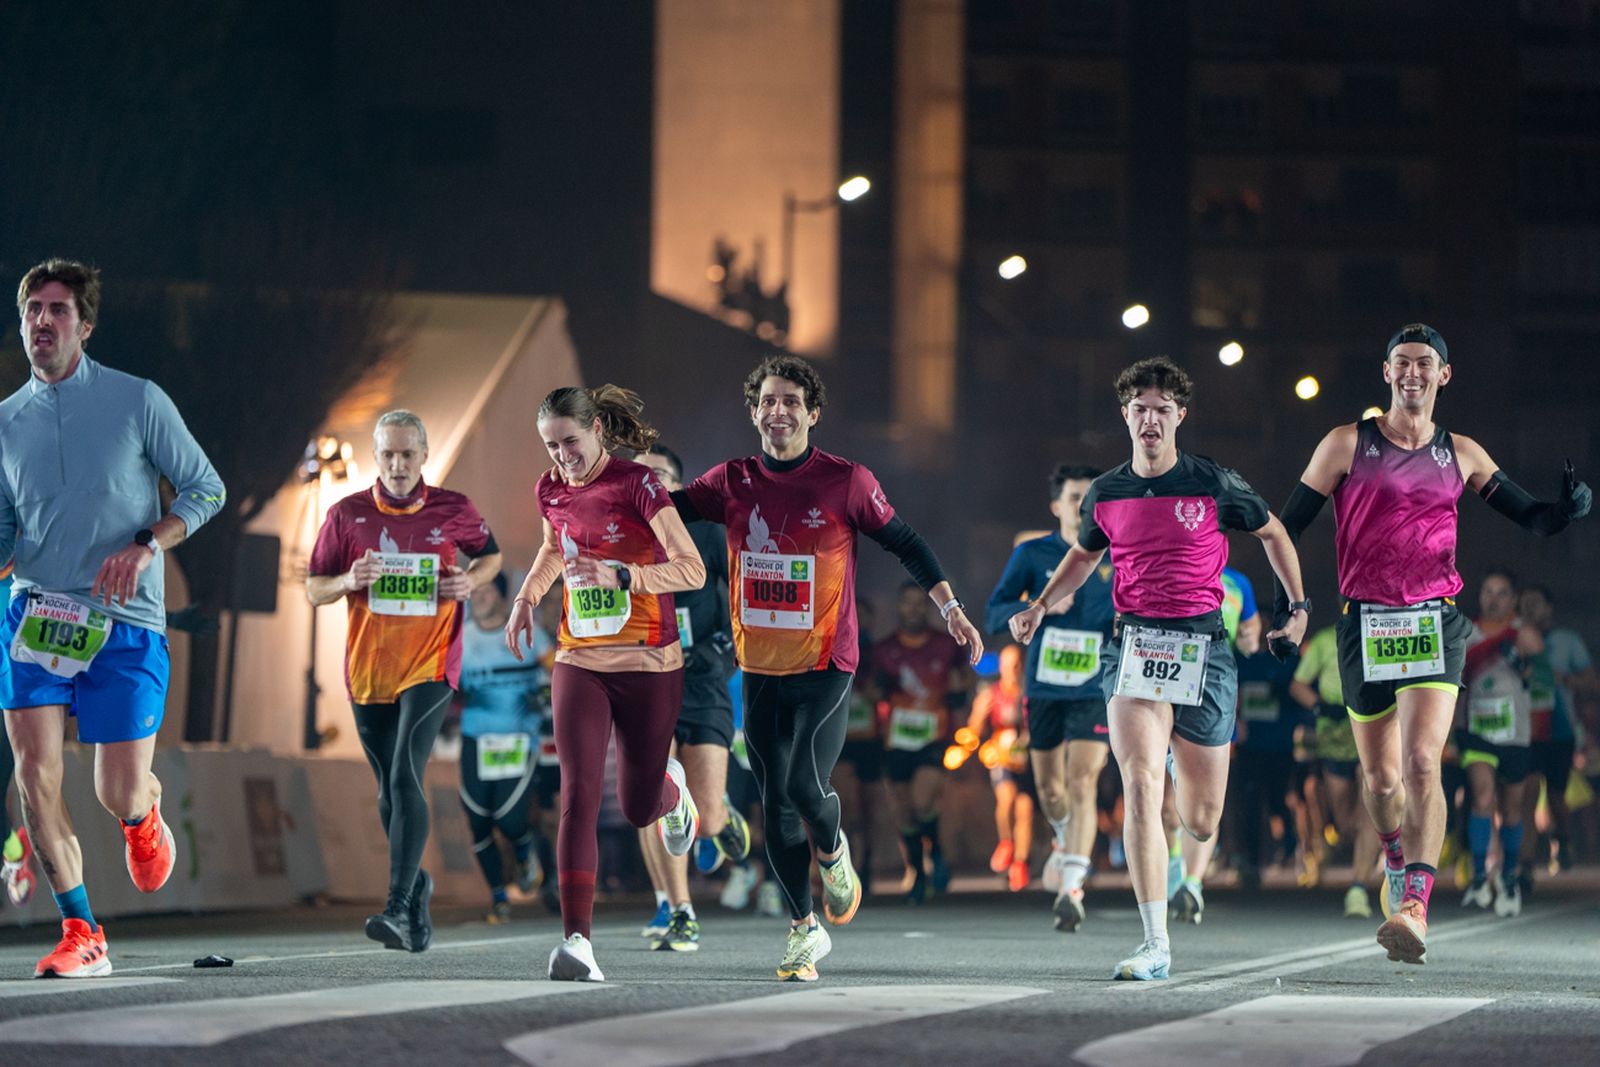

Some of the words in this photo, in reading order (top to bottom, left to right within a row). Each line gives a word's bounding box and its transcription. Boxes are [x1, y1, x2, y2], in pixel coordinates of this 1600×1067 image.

[754, 561, 774, 570] NOCHE
[775, 562, 784, 571] DE
[746, 569, 759, 577] SAN
[381, 574, 429, 594] 13813
[752, 580, 798, 604] 1098
[576, 587, 615, 612] 1393
[33, 607, 48, 617] SAN
[45, 599, 70, 611] NOCHE
[70, 603, 82, 613] DE
[1379, 620, 1401, 628] NOCHE
[1402, 619, 1412, 627] DE
[38, 619, 90, 652] 1193
[1370, 629, 1386, 637] SAN
[1143, 641, 1166, 651] NOCHE
[1166, 644, 1176, 652] DE
[1373, 634, 1432, 658] 13376
[1133, 649, 1148, 658] SAN
[1142, 659, 1182, 682] 892
